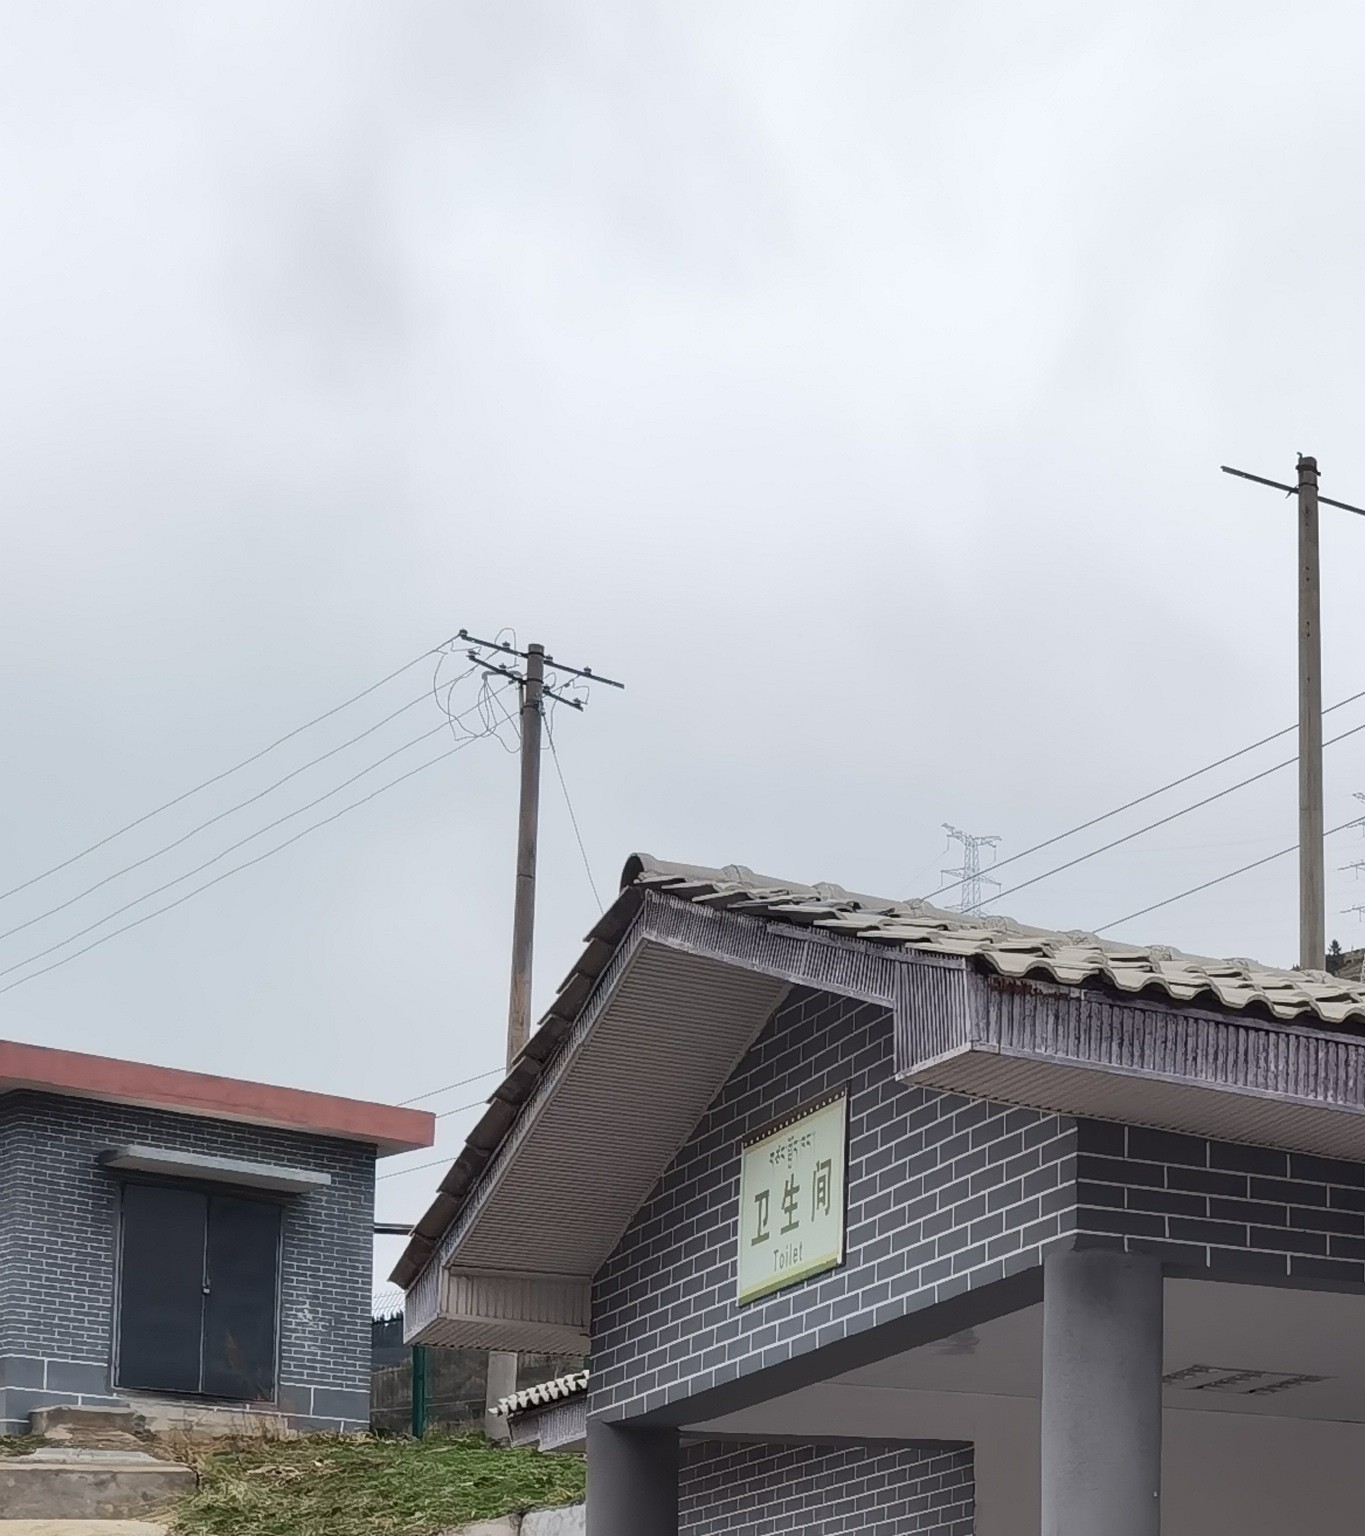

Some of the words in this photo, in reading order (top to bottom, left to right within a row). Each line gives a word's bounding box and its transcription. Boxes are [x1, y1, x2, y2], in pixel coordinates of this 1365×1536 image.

[751, 1158, 832, 1246] 卫生间
[773, 1242, 803, 1272] Toilet
